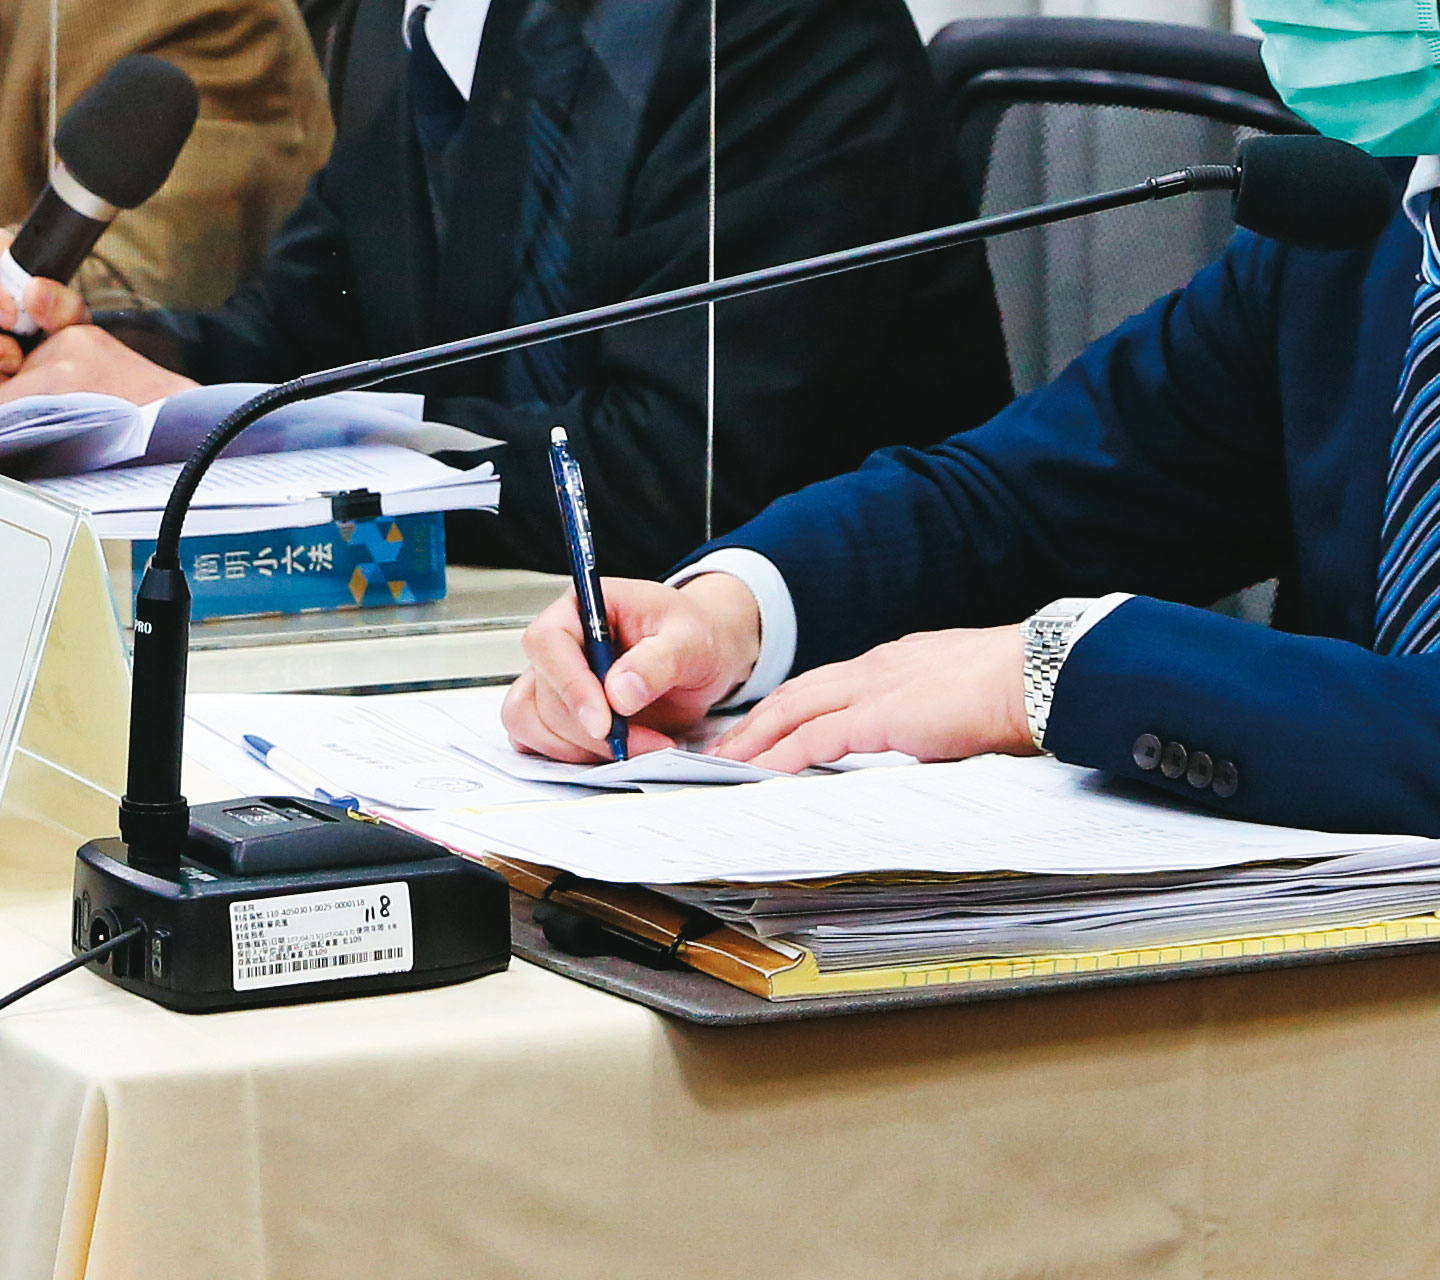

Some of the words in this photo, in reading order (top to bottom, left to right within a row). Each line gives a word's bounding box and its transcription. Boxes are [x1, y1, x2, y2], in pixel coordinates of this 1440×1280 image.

[193, 542, 334, 581] 簡明小六法
